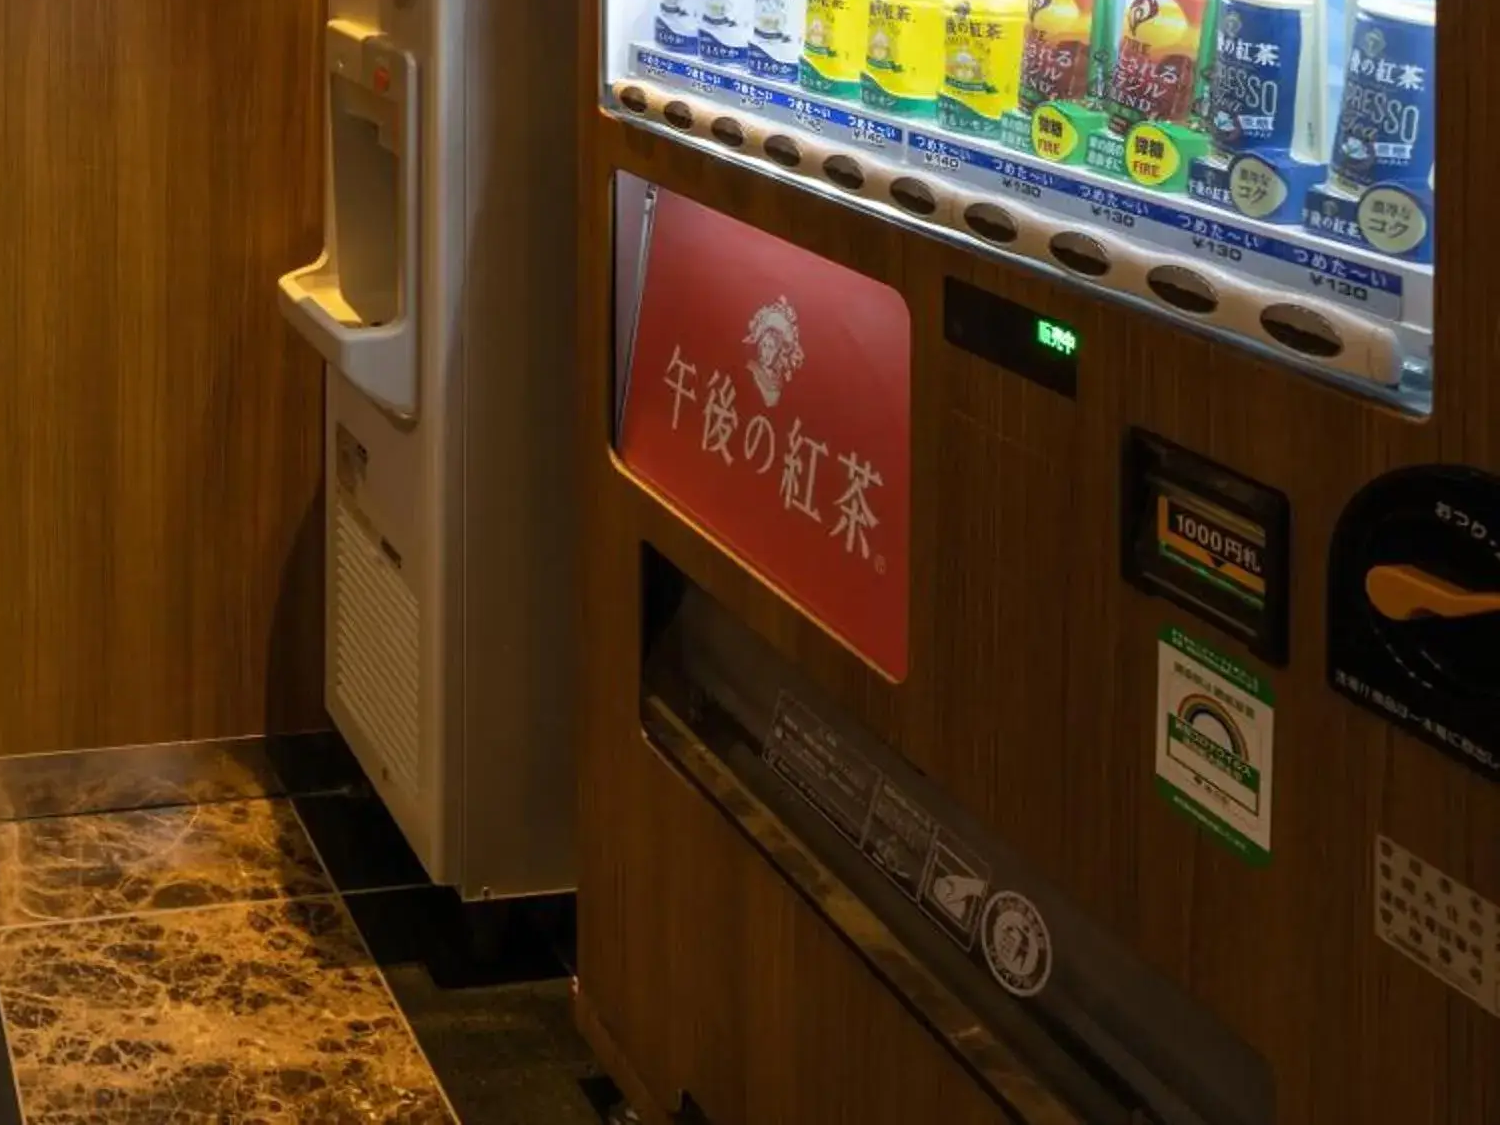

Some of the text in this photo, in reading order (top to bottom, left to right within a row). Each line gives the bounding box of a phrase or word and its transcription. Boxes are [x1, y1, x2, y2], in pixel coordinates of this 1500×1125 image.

[1132, 160, 1161, 178] FIRE
[662, 344, 884, 560] 午後の紅茶
[1176, 514, 1262, 573] 1000円札
